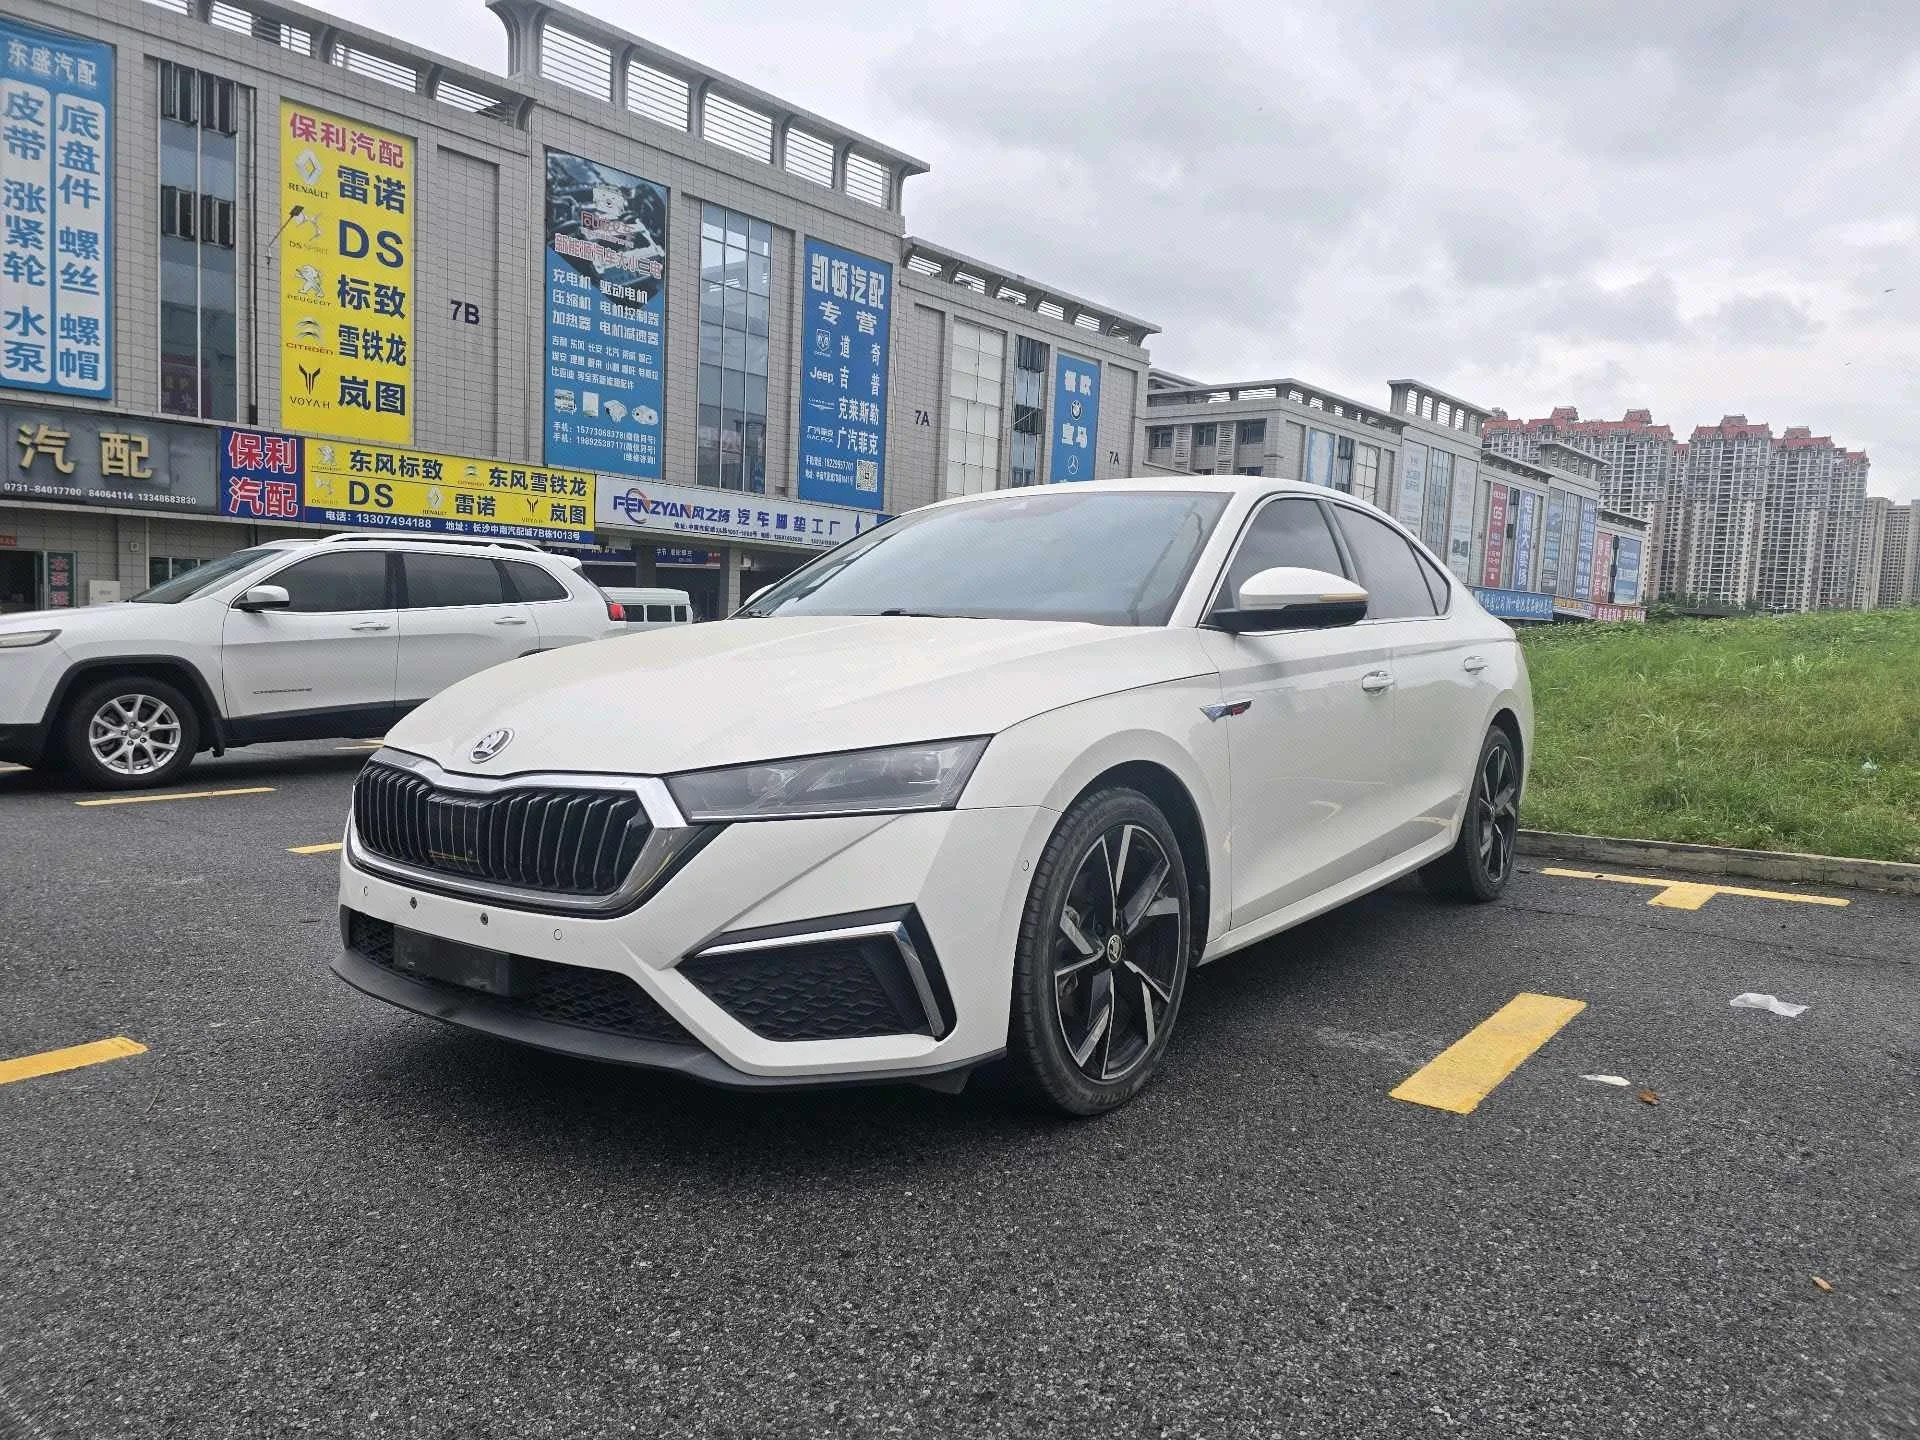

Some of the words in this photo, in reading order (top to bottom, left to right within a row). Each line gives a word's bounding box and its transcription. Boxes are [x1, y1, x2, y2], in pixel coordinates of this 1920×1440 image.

[7, 39, 96, 87] 东盛汽配
[3, 91, 45, 161] 皮带
[290, 112, 405, 169] 保利汽配
[58, 104, 100, 209] 底盘件
[337, 164, 405, 215] 雷诺
[3, 178, 46, 287] 涨紧轮
[339, 219, 404, 268] DS
[59, 227, 100, 296] 螺丝
[811, 253, 885, 311] 凯顿汽配
[337, 274, 406, 320] 标致
[450, 299, 481, 326] 7B
[3, 305, 46, 373] 水泵
[818, 301, 877, 336] 专营
[59, 313, 100, 381] 螺帽
[338, 324, 407, 368] 雪铁龙
[338, 376, 406, 416] 岚图
[810, 367, 834, 384] Jeep
[290, 395, 330, 409] VOYAH
[838, 396, 879, 426] 克莱斯勒
[915, 410, 930, 427] 7A
[17, 423, 153, 479] 汽配
[228, 431, 297, 475] 保利
[837, 426, 878, 456] 广汽菲克
[1109, 452, 1119, 466] 7A
[350, 449, 443, 481] 东风标致
[488, 466, 587, 497] 东风雪铁龙
[228, 476, 298, 518] 汽配
[349, 480, 393, 508] DS
[455, 493, 496, 517] 雷诺
[550, 503, 586, 525] 岚图
[692, 505, 730, 523] 风之扬
